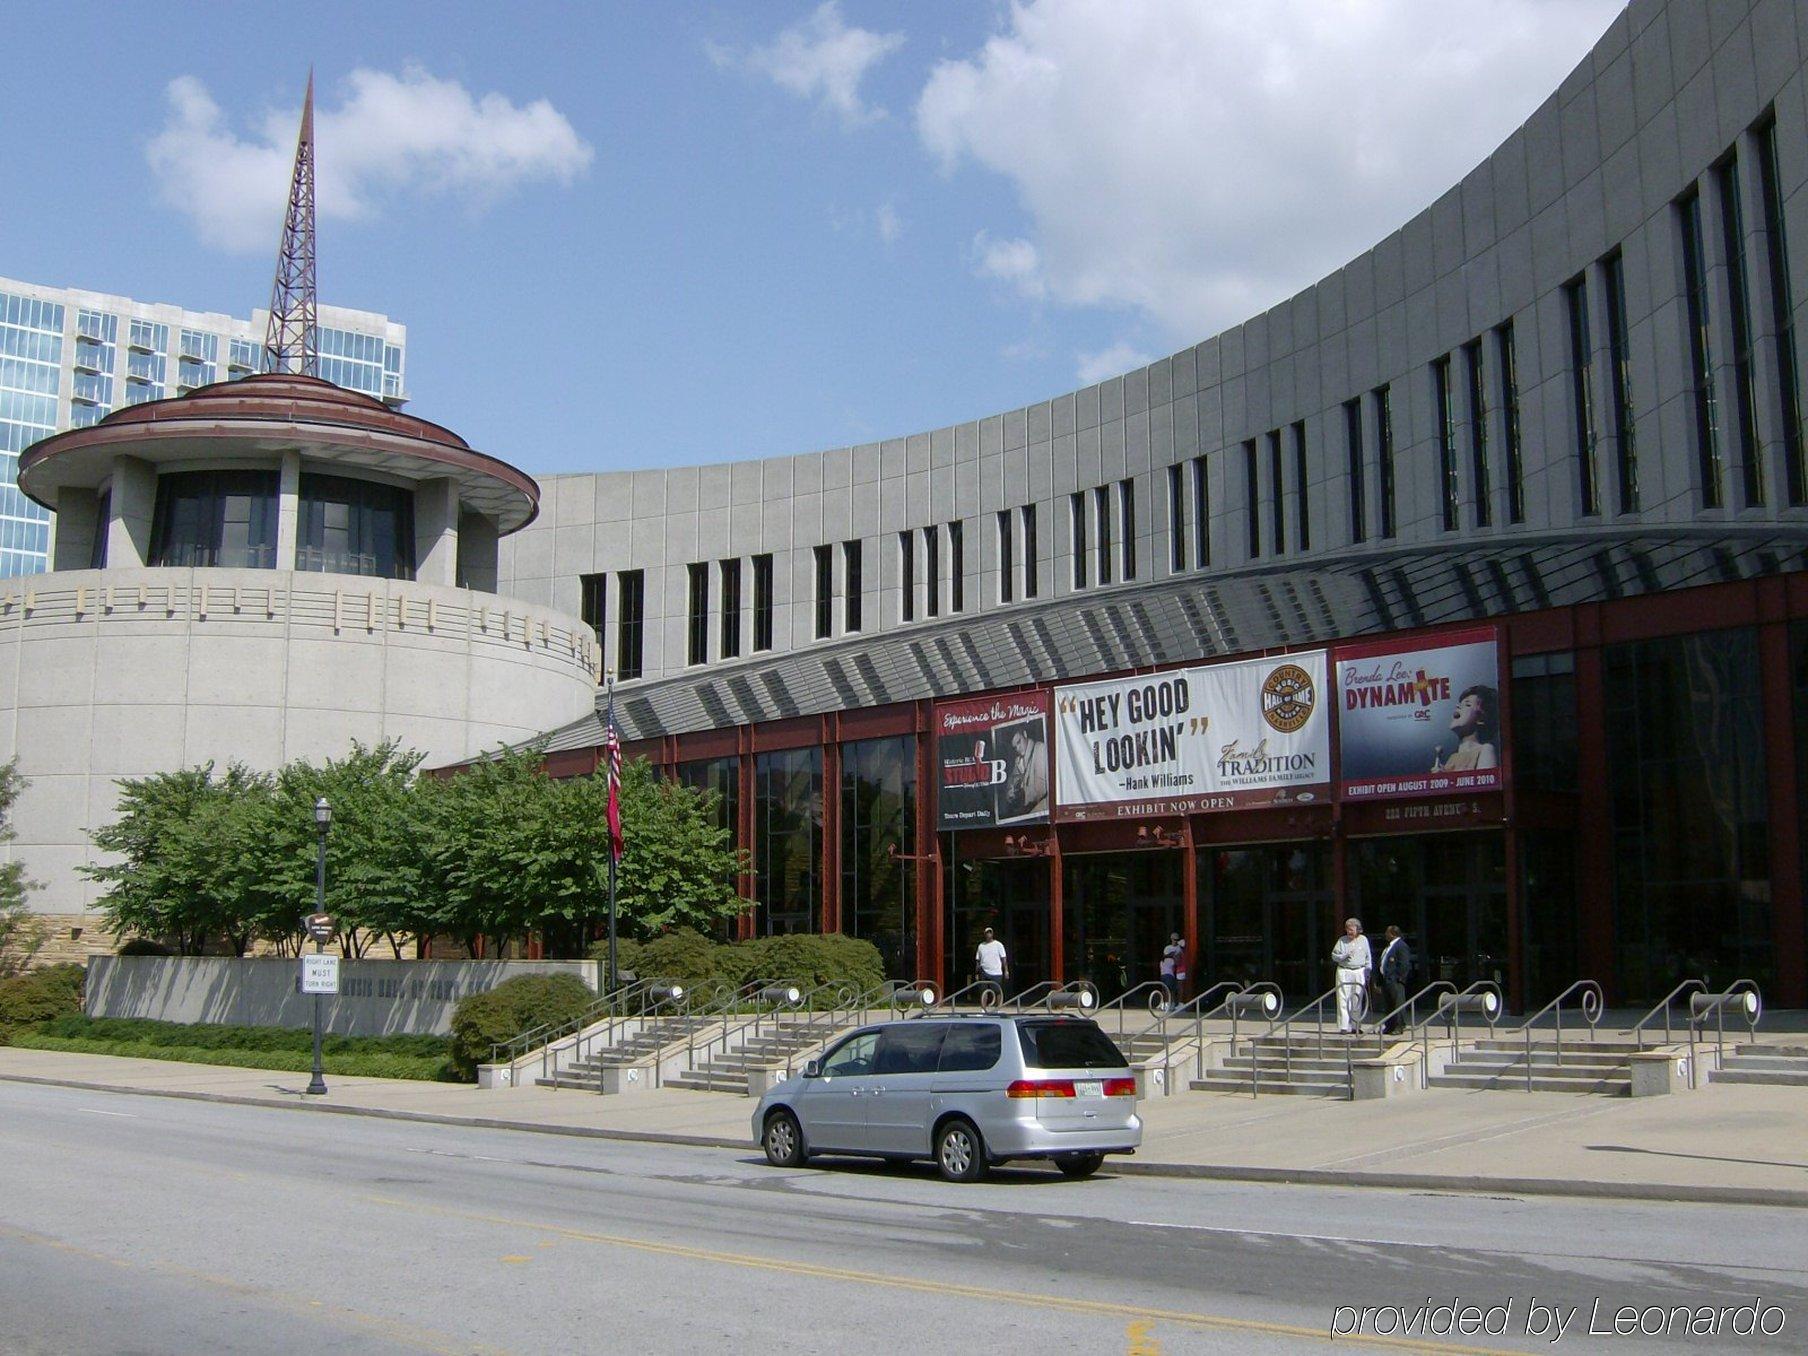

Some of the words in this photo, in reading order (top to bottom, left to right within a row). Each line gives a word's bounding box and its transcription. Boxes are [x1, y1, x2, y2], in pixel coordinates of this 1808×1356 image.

[1267, 670, 1310, 689] COUNTRY
[1345, 664, 1383, 686] Brenda
[1275, 679, 1300, 692] MUSIC
[1346, 670, 1450, 710] DYNAMITE
[1127, 678, 1190, 724] GOOD
[1264, 692, 1283, 711] HALL
[943, 712, 990, 729] Experience
[991, 702, 1006, 719] the
[1008, 702, 1039, 723] Magic
[989, 760, 1007, 784] B
[1219, 752, 1315, 777] TRADITION
[1151, 774, 1194, 788] Williams
[1232, 775, 1267, 786] WILLIAMS
[1269, 773, 1293, 782] FAMILY
[1348, 784, 1375, 796] EXHIBIT
[1377, 782, 1396, 793] OPEN
[1398, 780, 1427, 792] AUGUST
[1430, 778, 1449, 789] 2009
[1456, 776, 1475, 787] JUNE
[1476, 774, 1495, 785] 2010
[1117, 802, 1166, 817] EXHIBIT
[1170, 800, 1197, 813] NOW
[1201, 797, 1234, 810] OPEN
[1404, 806, 1430, 819] FIFTH
[311, 969, 331, 977] MUST
